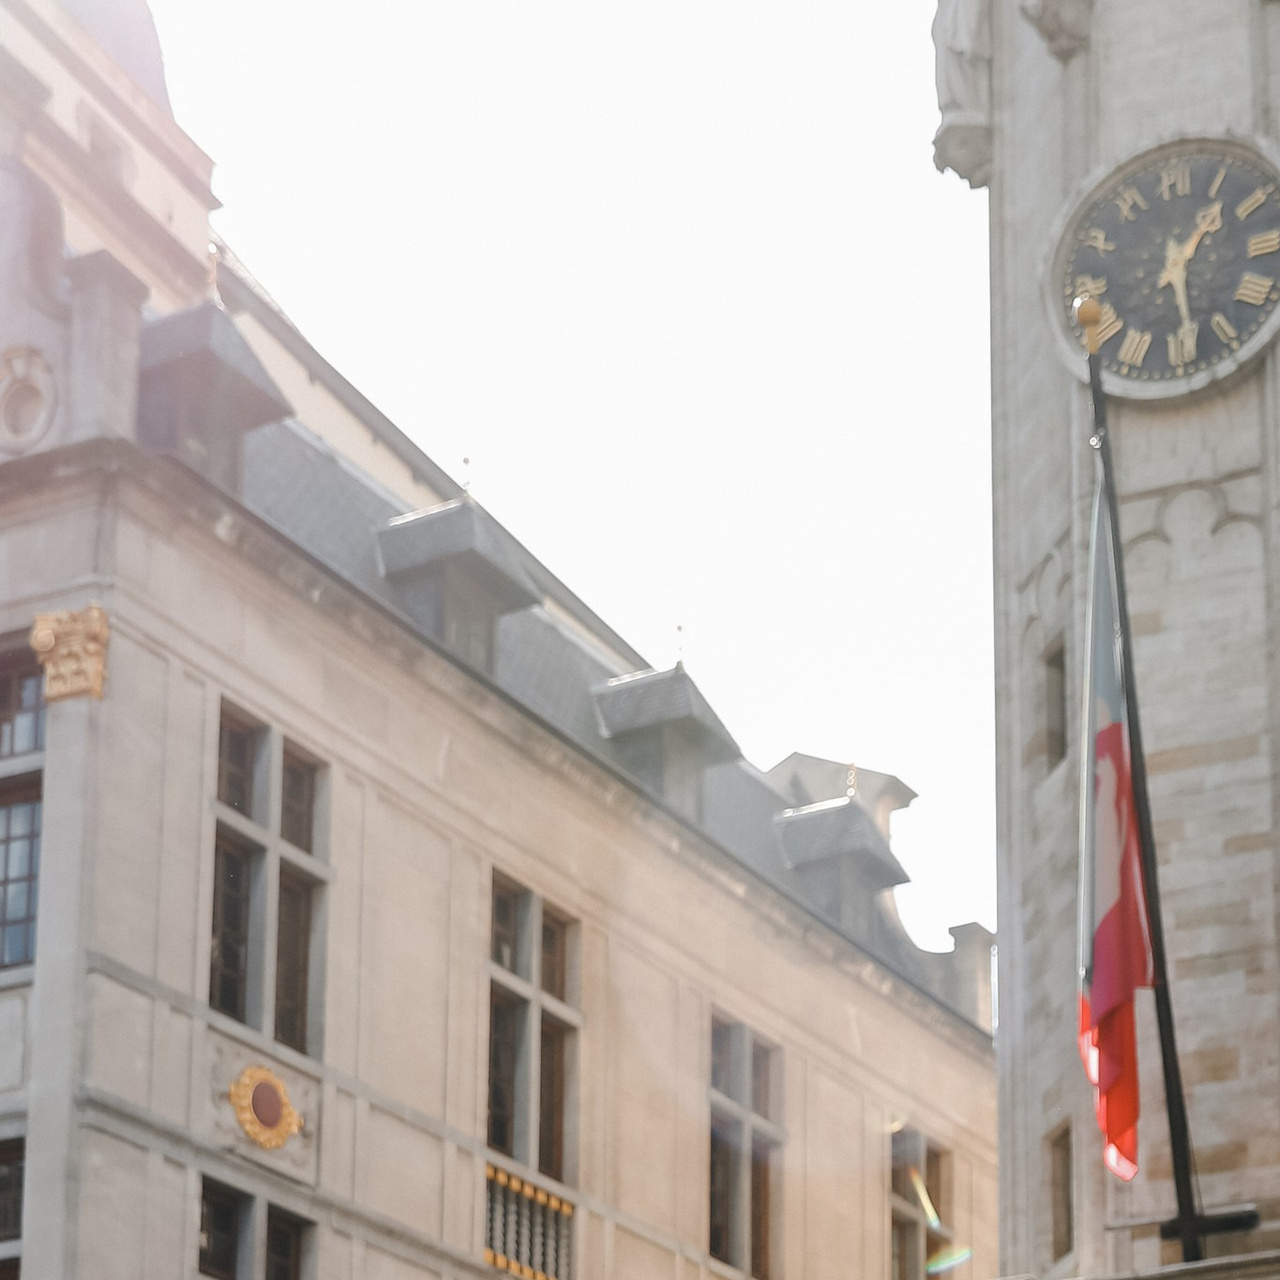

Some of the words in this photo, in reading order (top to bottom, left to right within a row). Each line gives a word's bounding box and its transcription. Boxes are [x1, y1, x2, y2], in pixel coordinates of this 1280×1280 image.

[1156, 167, 1192, 201] XII
[1208, 167, 1227, 199] I
[1115, 187, 1149, 223] XI
[1234, 187, 1268, 222] II
[1078, 227, 1116, 258] X
[1233, 271, 1275, 307] IIII
[1210, 312, 1239, 344] V
[1117, 329, 1153, 368] VII
